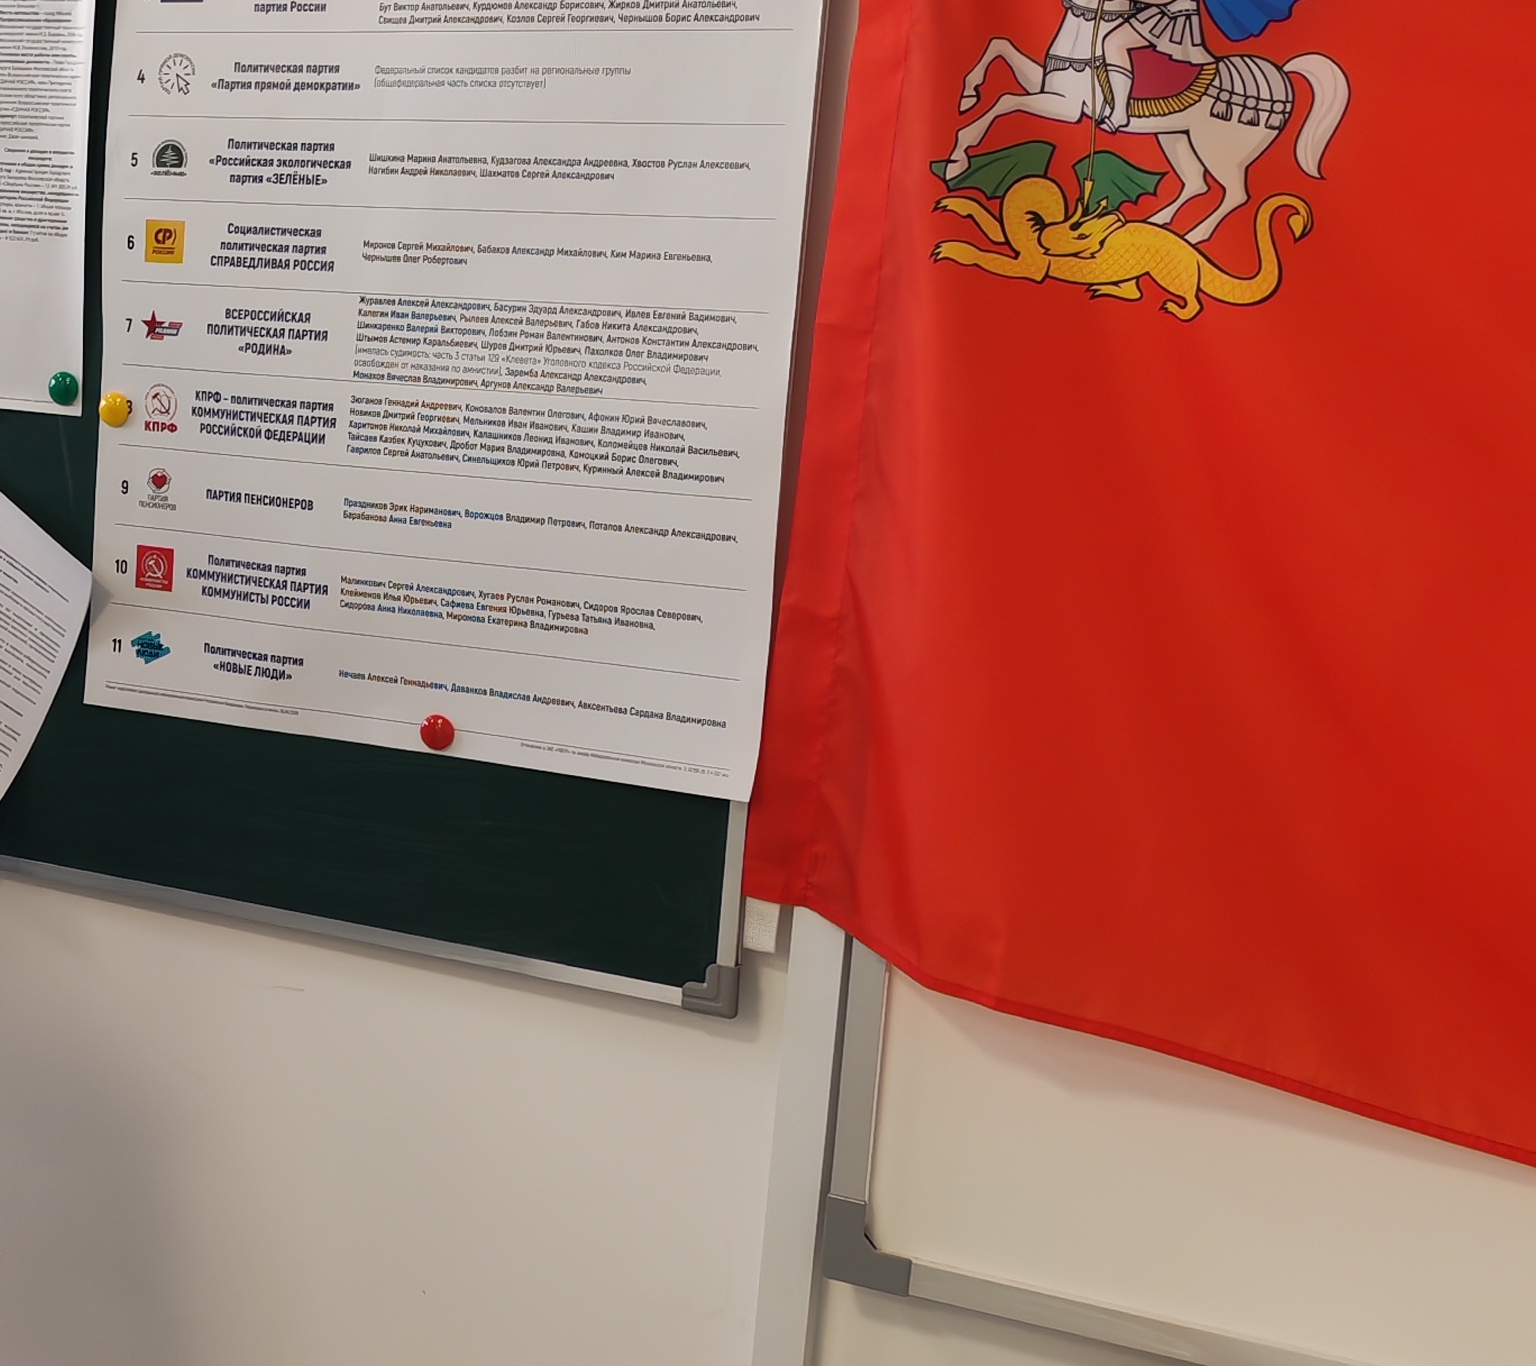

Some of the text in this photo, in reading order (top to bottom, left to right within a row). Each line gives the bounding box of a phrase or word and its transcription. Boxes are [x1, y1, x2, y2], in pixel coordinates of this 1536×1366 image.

[253, 0, 326, 14] партия России
[233, 61, 340, 75] Политическая партия
[136, 69, 146, 84] 4
[210, 78, 360, 92] «Партия прямой демократии»
[227, 138, 335, 153] Политическая партия
[130, 153, 138, 167] 5
[208, 154, 351, 172] «Российская экологическая
[229, 171, 328, 185] партия «ЗЕЛЁНЫЕ»
[227, 223, 322, 237] Социалистическая
[127, 235, 135, 250] 6
[219, 241, 327, 256] политическая партия
[210, 255, 334, 271] СПРАВЕДЛИВАЯ РОССИЯ
[224, 308, 311, 323] ВСЕРОССИЙСКАЯ
[126, 319, 132, 333] 7
[206, 323, 328, 341] ПОЛИТИЧЕСКАЯ ПАРТИЯ
[238, 342, 292, 355] «РОДИНА»
[194, 390, 334, 412] КПРФ политическая партия
[191, 406, 337, 428] КОММУНИСТИЧЕСКАЯ ПАРТИЯ
[144, 420, 178, 433] КПРФ
[199, 423, 326, 444] РОССИЙСКОЙ ФЕДЕРАЦИИ
[120, 479, 129, 495] 9
[205, 488, 314, 510] ПАРТИЯ ПЕНСИОНЕРОВ
[114, 559, 128, 575] 10
[207, 554, 306, 577] Политическая партия
[186, 568, 288, 590] КОММУНИСТИЧЕСКАЯ
[289, 581, 328, 595] ПАРТИЯ
[201, 585, 310, 609] КОММУНИСТЫ РОССИИ
[112, 638, 122, 653] 11
[203, 642, 304, 666] Политическая партия
[212, 661, 292, 680] «НОВЫЕ ЛЮДИ»
